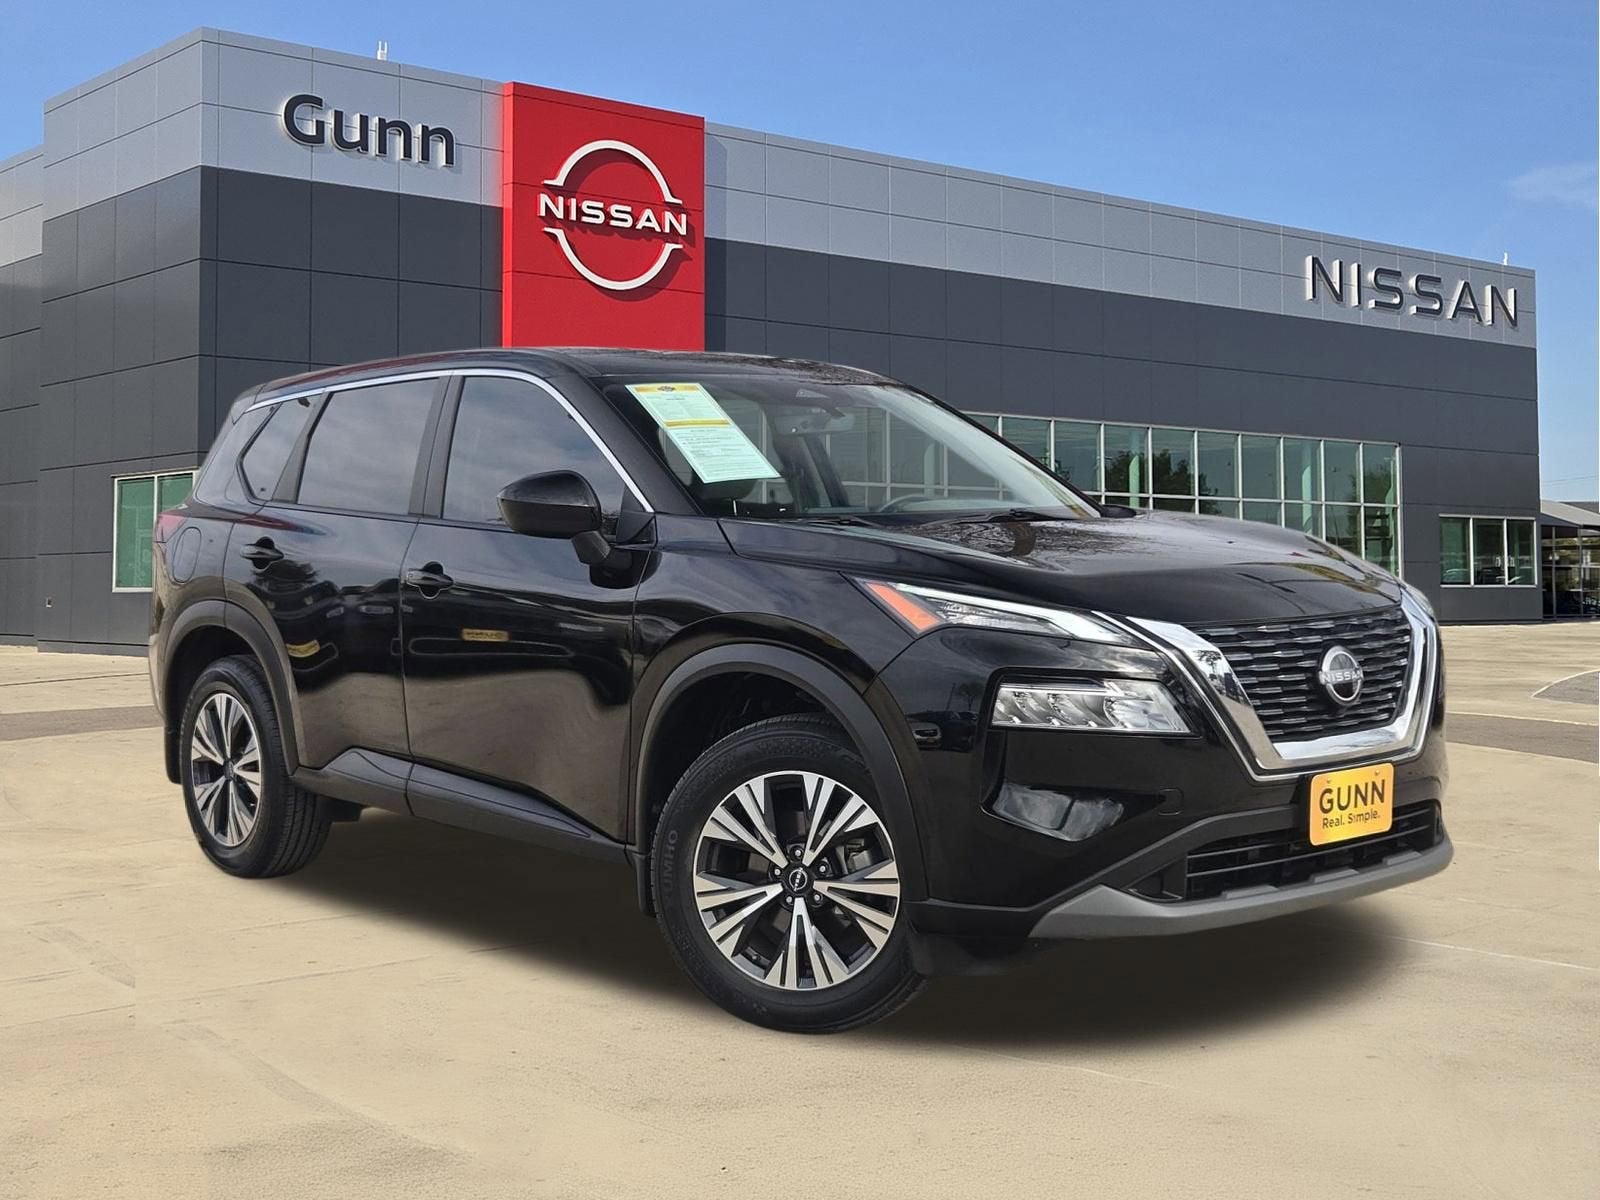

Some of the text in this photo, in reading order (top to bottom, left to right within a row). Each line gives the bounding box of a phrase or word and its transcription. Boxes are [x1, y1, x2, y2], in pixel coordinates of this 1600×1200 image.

[281, 93, 456, 167] Gunn
[538, 193, 687, 236] NISSAN
[1305, 255, 1518, 328] NISSAN
[1319, 668, 1364, 685] NISSAN
[1319, 779, 1385, 814] GUNN
[1322, 808, 1380, 829] Real. Simple.
[663, 829, 678, 904] UMHO
